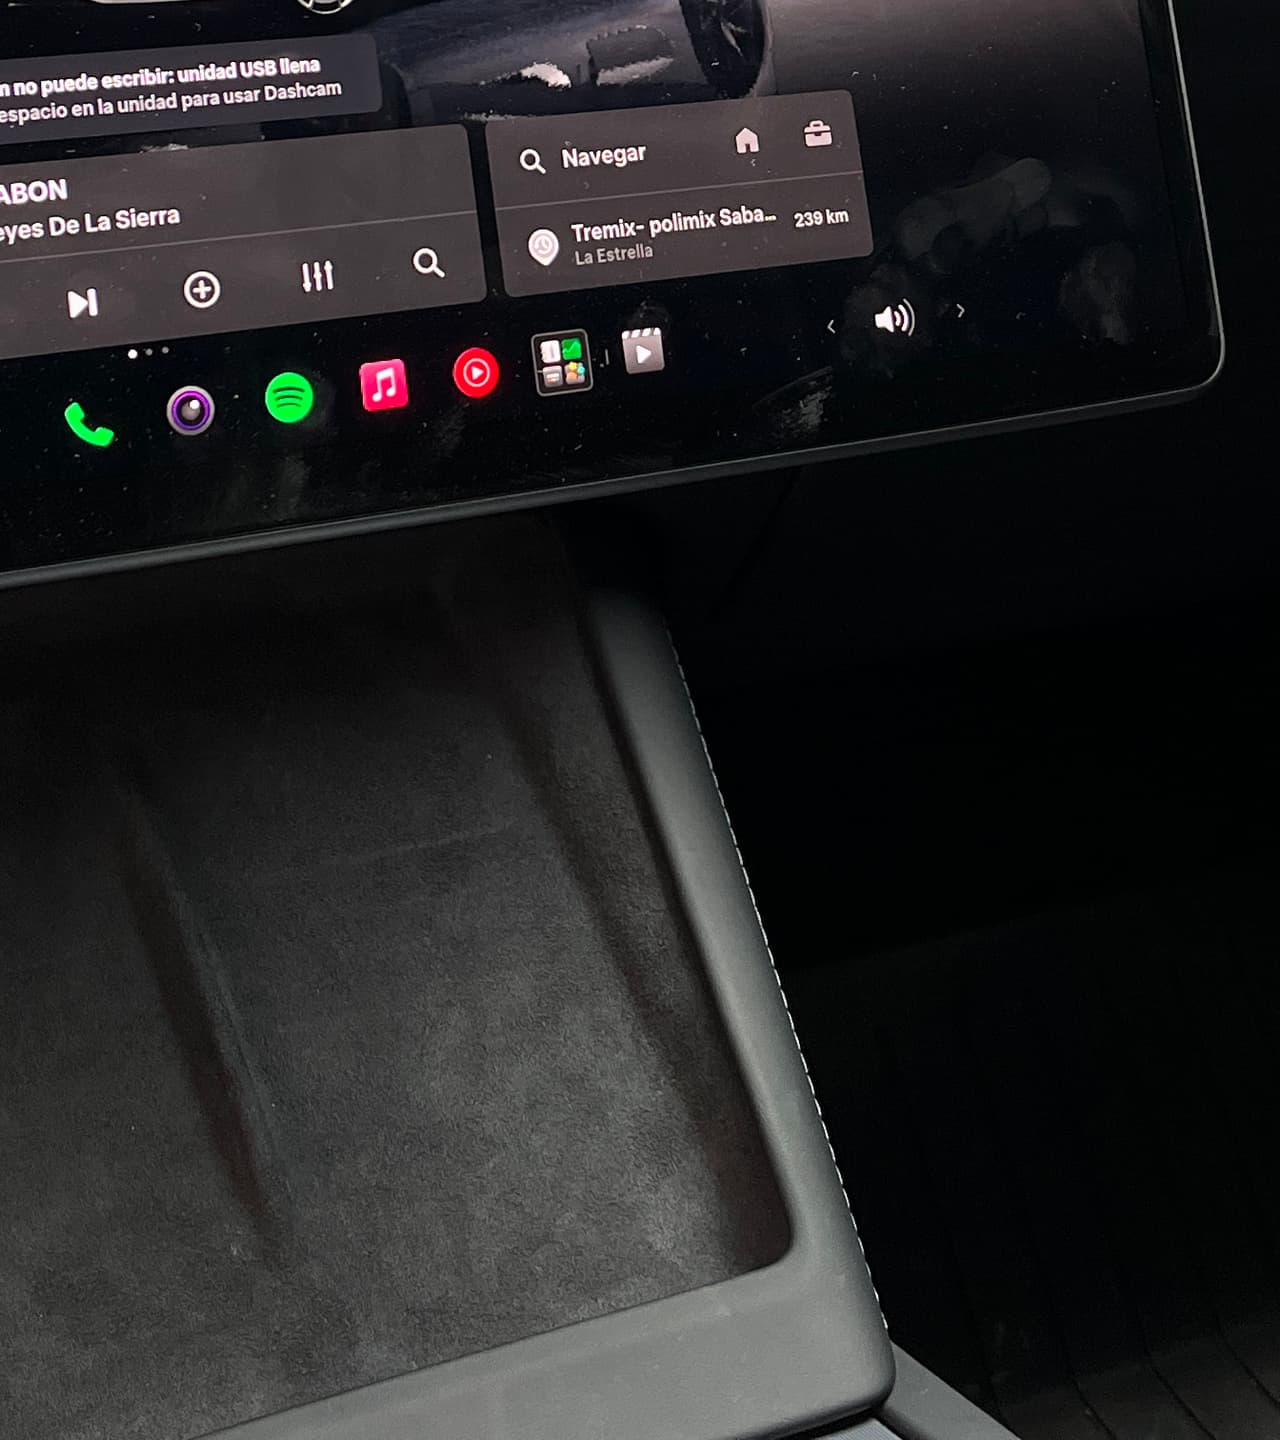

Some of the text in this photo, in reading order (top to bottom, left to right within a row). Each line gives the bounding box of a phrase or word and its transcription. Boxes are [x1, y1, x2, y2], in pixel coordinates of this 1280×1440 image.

[13, 80, 38, 96] no
[41, 73, 99, 98] puede
[101, 66, 175, 90] escribir:
[176, 61, 237, 84] unidad
[239, 59, 277, 78] USB
[278, 57, 320, 75] llena
[71, 103, 95, 117] en
[97, 98, 114, 115] la
[117, 92, 178, 114] unidad
[181, 90, 220, 112] para
[223, 88, 261, 104] usar
[263, 81, 342, 101] Dashcam
[561, 143, 647, 169] Navegar
[49, 215, 81, 237] De
[84, 212, 111, 233] La
[115, 205, 181, 230] Sierra
[571, 221, 644, 242] Tremix-
[649, 212, 715, 237] polimix
[794, 208, 850, 229] 239 km
[574, 243, 654, 266] La Estrella
